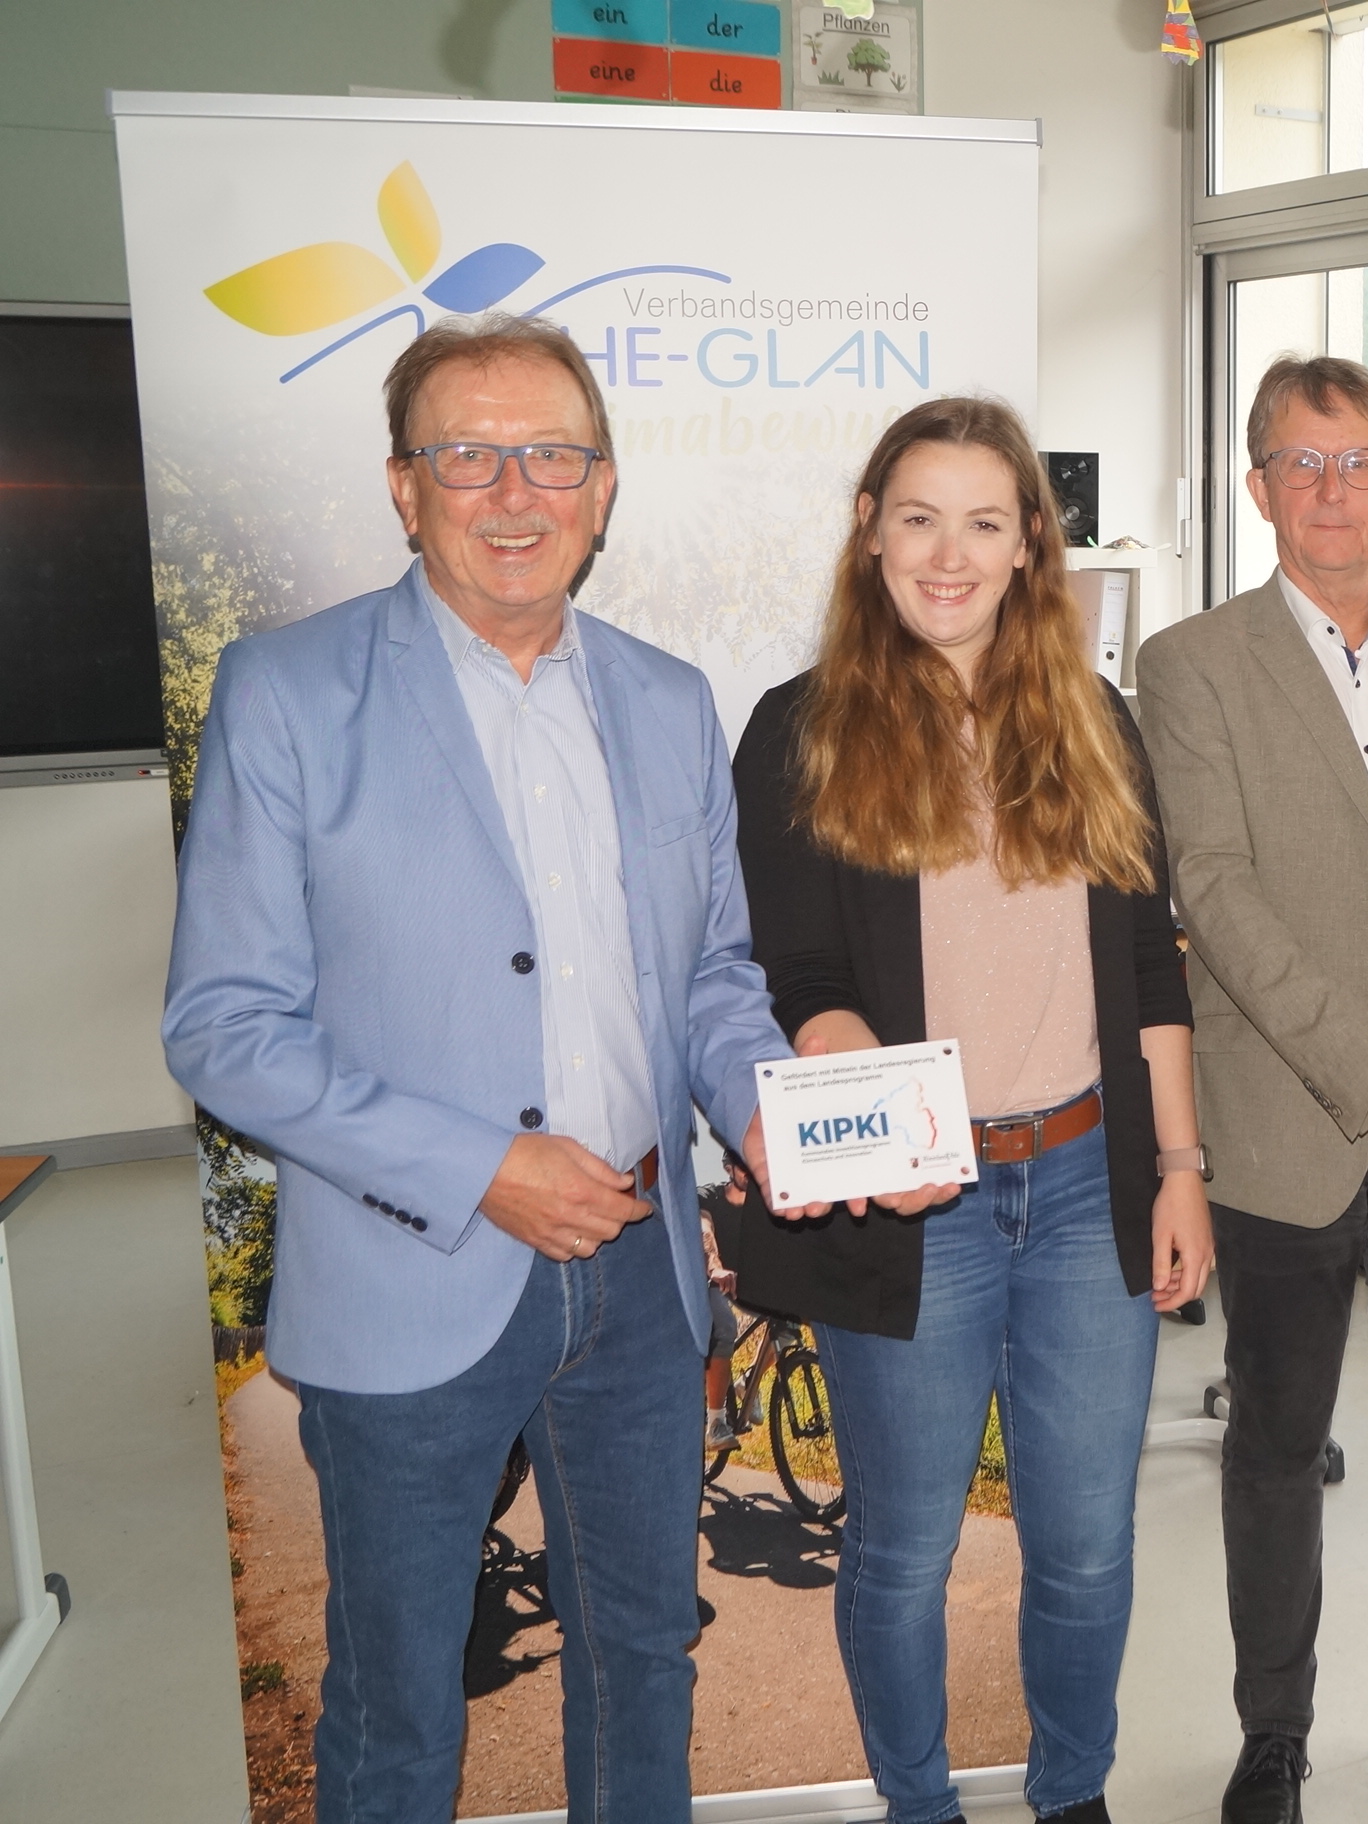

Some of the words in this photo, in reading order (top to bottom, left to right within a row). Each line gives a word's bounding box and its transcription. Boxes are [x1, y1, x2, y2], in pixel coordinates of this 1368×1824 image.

[593, 3, 628, 25] ein
[706, 13, 743, 38] der
[823, 13, 890, 34] Pflanzen
[589, 60, 636, 82] eine
[709, 69, 743, 94] die
[623, 287, 930, 327] Verbandsgemeinde
[560, 325, 930, 389] HE-GLAN
[797, 1111, 890, 1148] KIPKI
